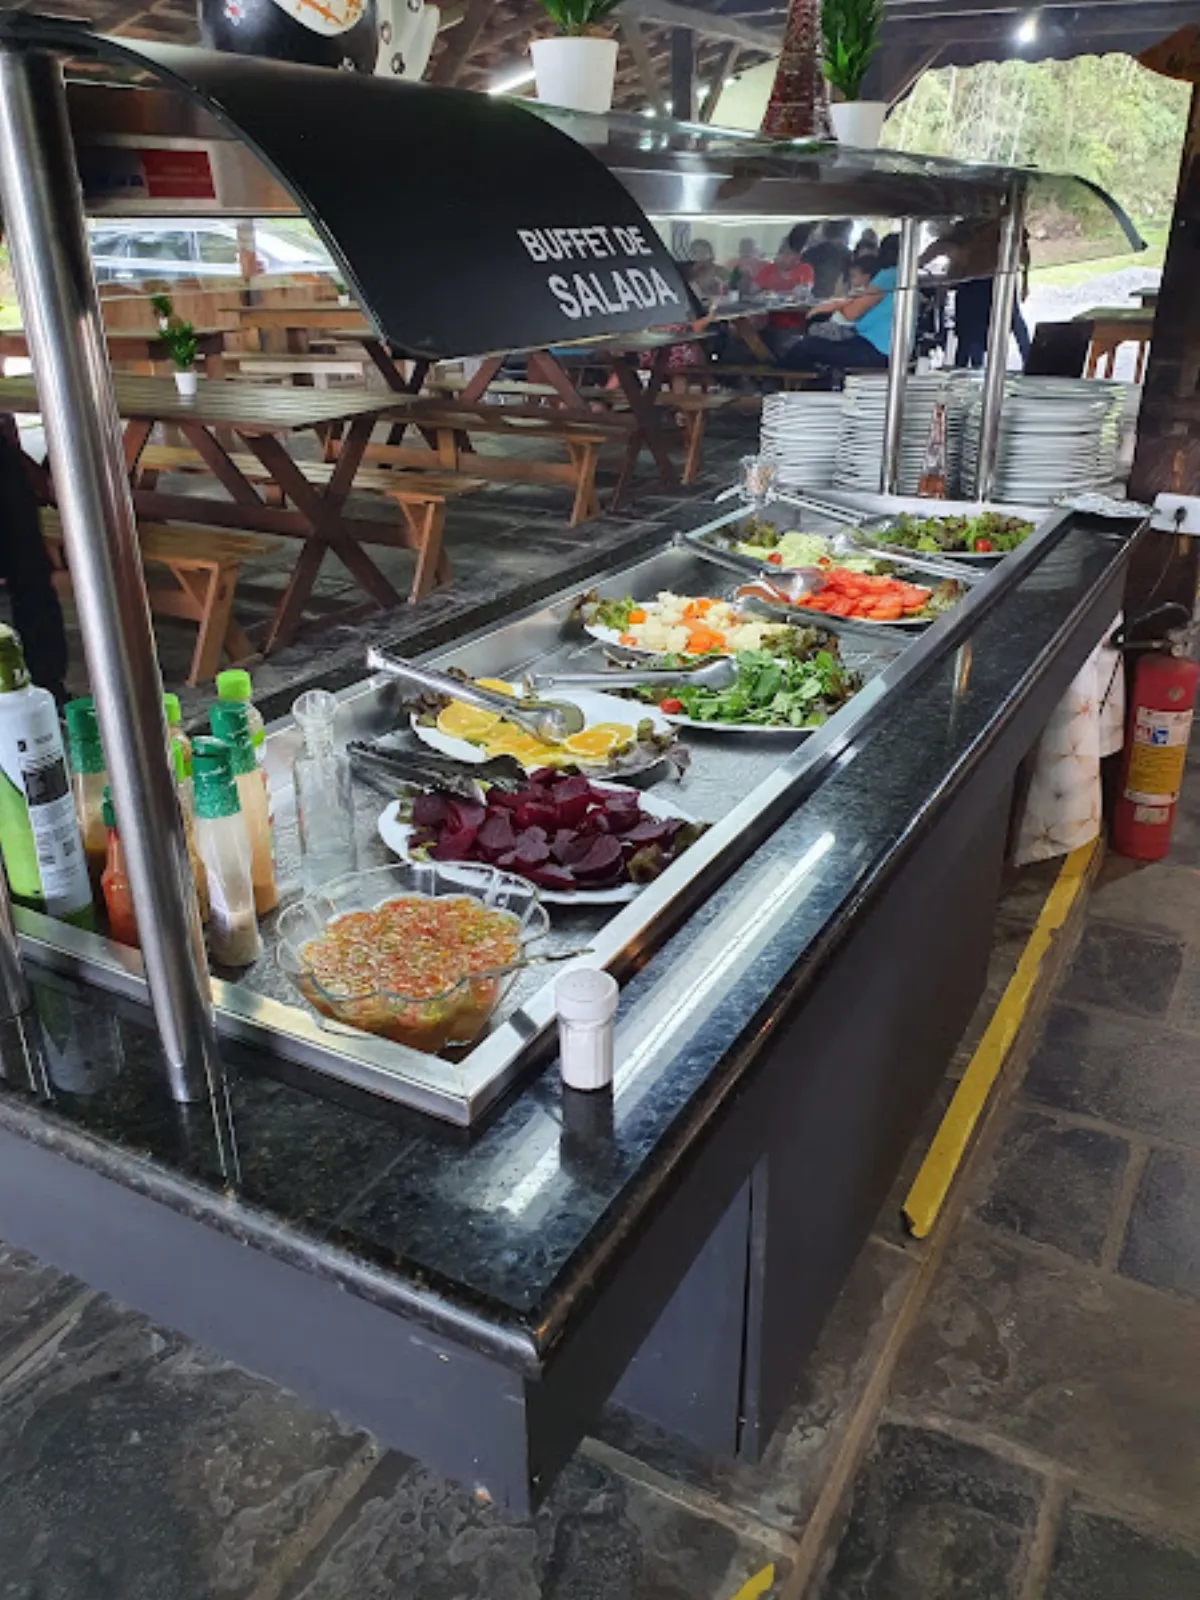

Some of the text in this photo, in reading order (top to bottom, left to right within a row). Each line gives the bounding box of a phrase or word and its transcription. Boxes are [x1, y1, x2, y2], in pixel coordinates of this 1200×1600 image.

[517, 226, 652, 262] BUFFET DE
[548, 267, 680, 320] SALADA
